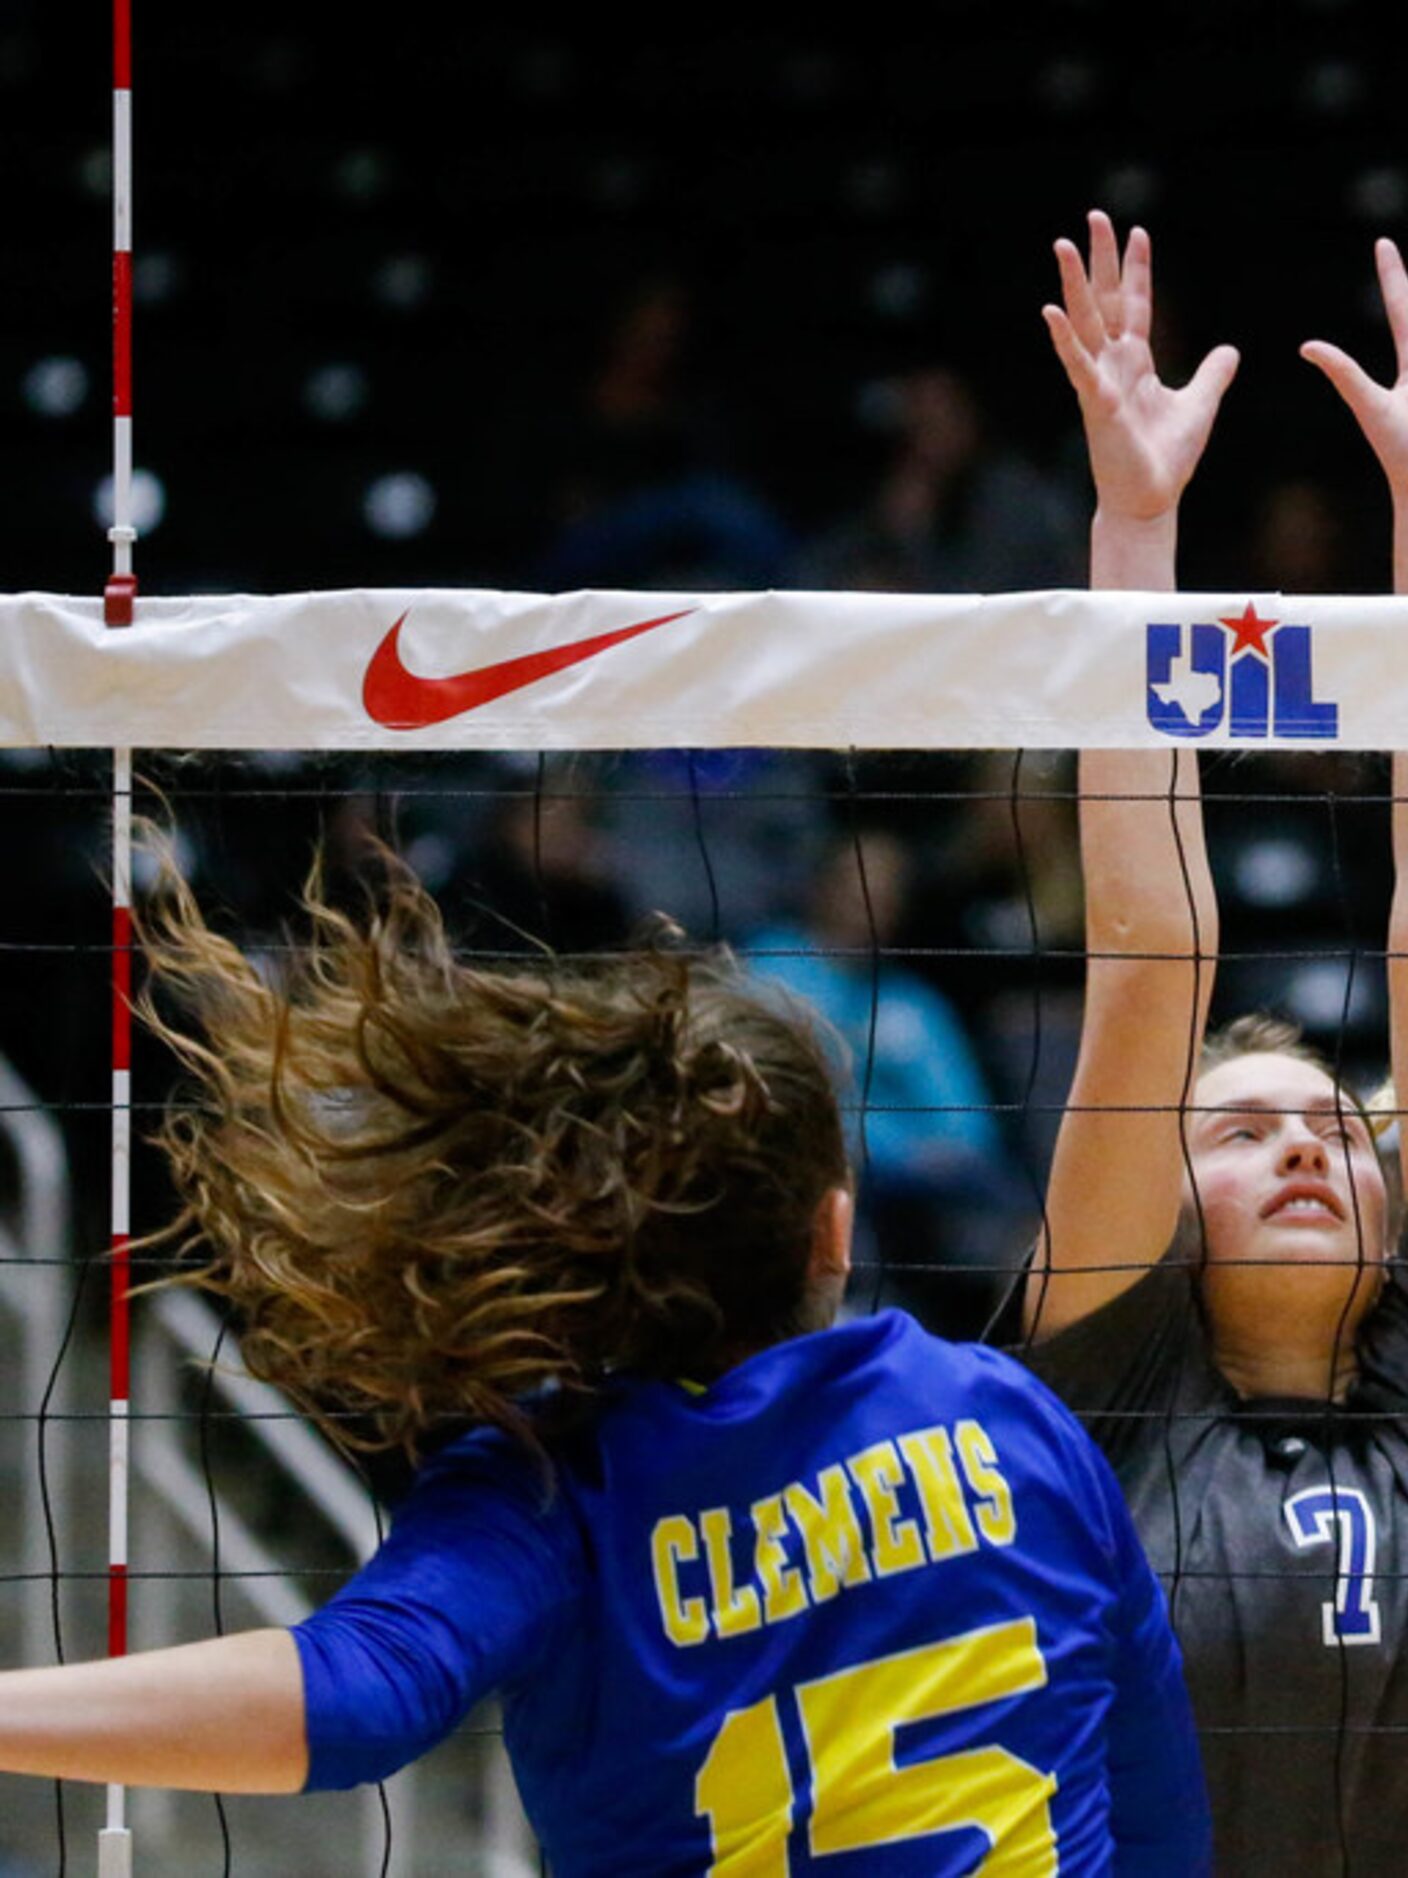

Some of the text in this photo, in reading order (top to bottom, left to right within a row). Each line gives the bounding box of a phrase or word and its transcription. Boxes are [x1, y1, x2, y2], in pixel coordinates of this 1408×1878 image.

[651, 1418, 1017, 1647] CLEMENS
[1283, 1485, 1381, 1646] 7
[694, 1615, 1059, 1878] 15
